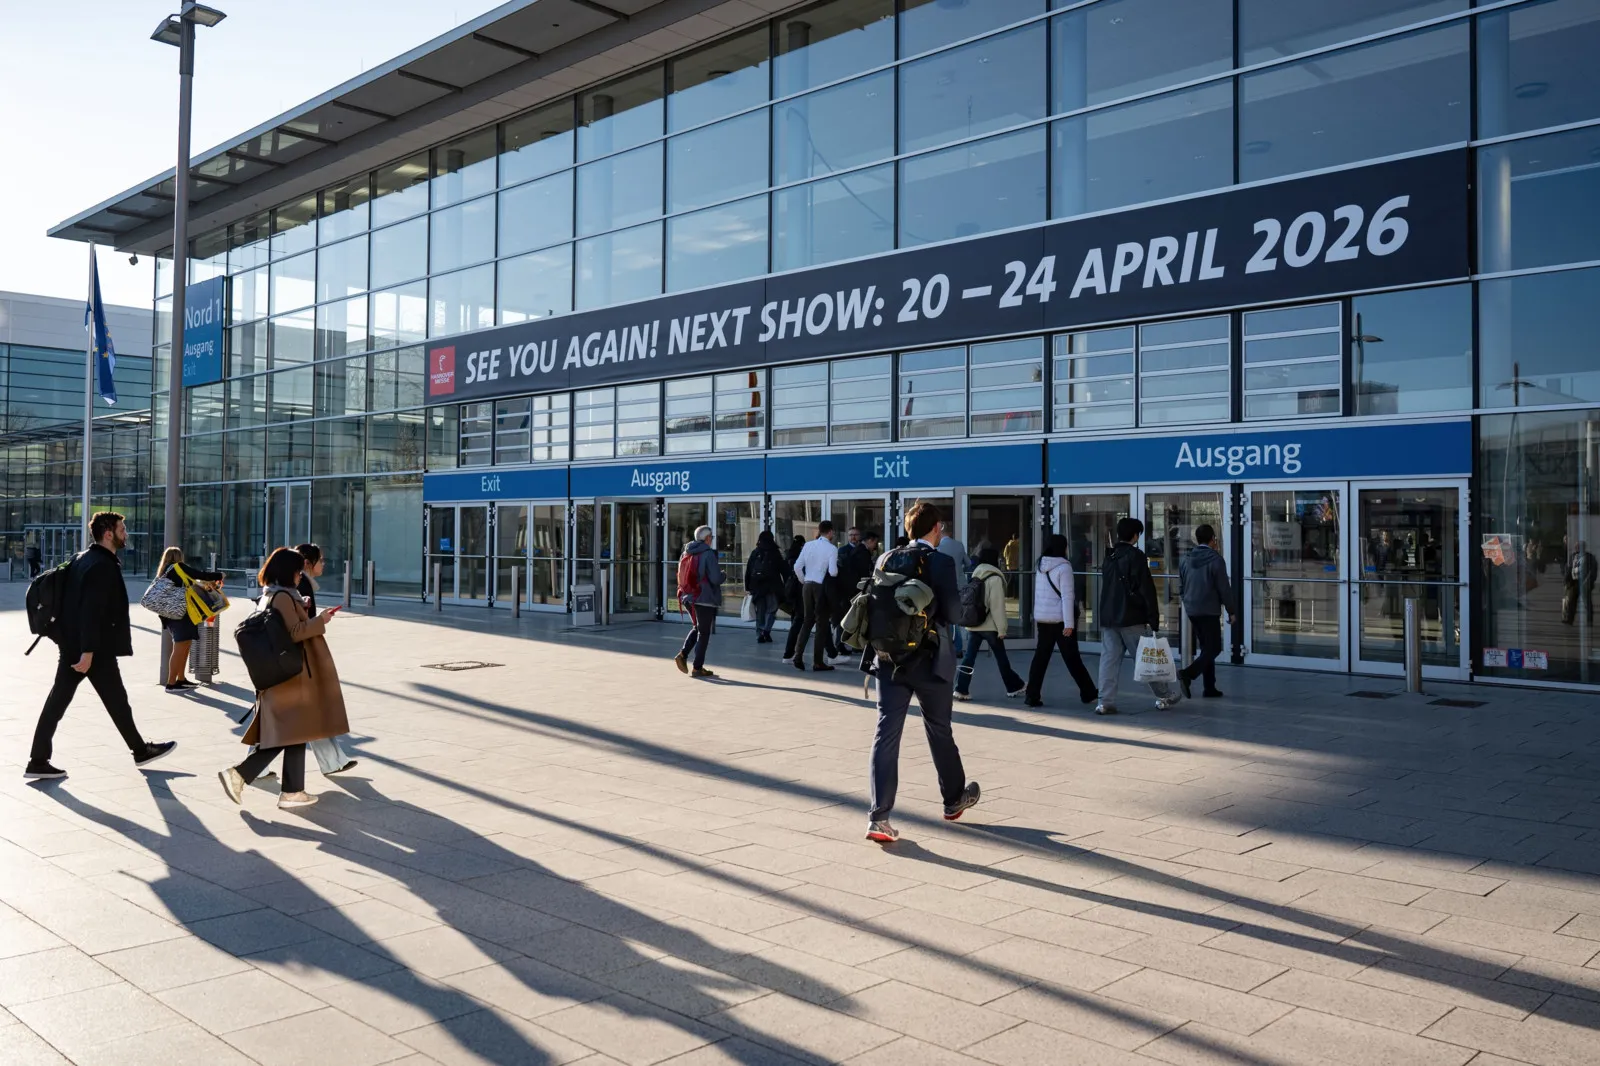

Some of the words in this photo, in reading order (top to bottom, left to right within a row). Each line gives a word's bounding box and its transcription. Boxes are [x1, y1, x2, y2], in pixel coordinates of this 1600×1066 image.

[465, 348, 501, 384] SEE
[509, 339, 558, 378] YOU
[562, 319, 660, 370] AGAIN!
[667, 306, 751, 356] NEXT
[758, 285, 885, 342] SHOW:
[897, 273, 950, 323] 20
[998, 255, 1057, 309] 24
[1069, 228, 1225, 299] APRIL
[1244, 195, 1410, 275] 2026
[185, 298, 213, 330] Nord
[215, 298, 221, 322] 1
[184, 340, 214, 358] Ausgang
[183, 362, 196, 377] Exit
[873, 455, 910, 480] Exit
[1175, 442, 1303, 477] Ausgang
[481, 474, 501, 492] Exit
[631, 468, 691, 493] Ausgang
